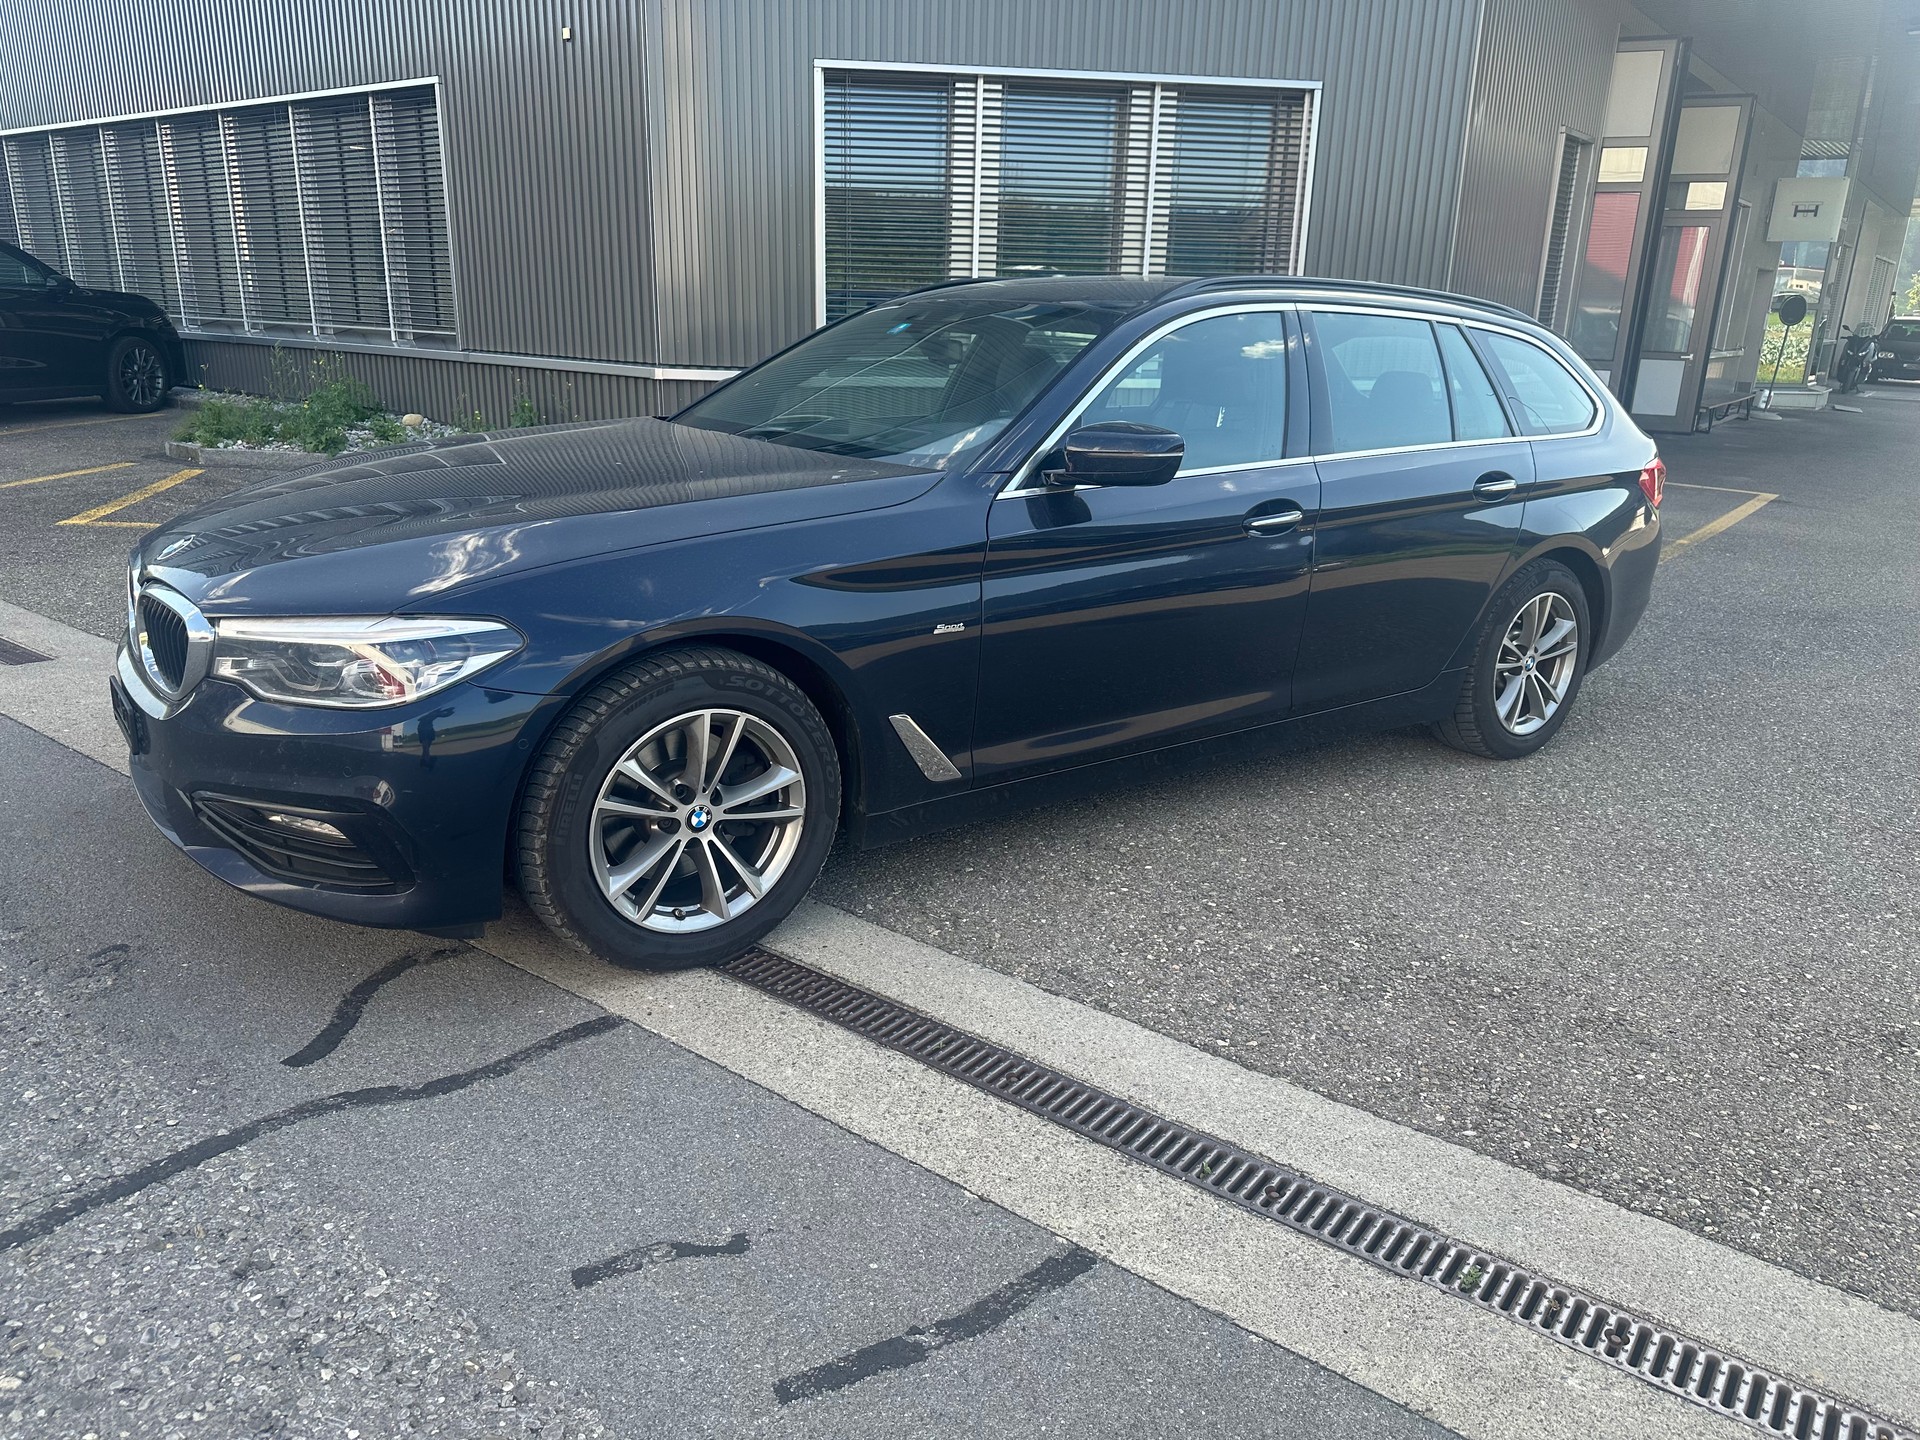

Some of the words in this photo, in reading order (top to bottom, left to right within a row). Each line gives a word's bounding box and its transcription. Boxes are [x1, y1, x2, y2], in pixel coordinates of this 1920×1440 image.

[933, 622, 966, 635] Sport
[725, 675, 836, 784] SOTTOZERO
[551, 771, 585, 846] PIRELLI
